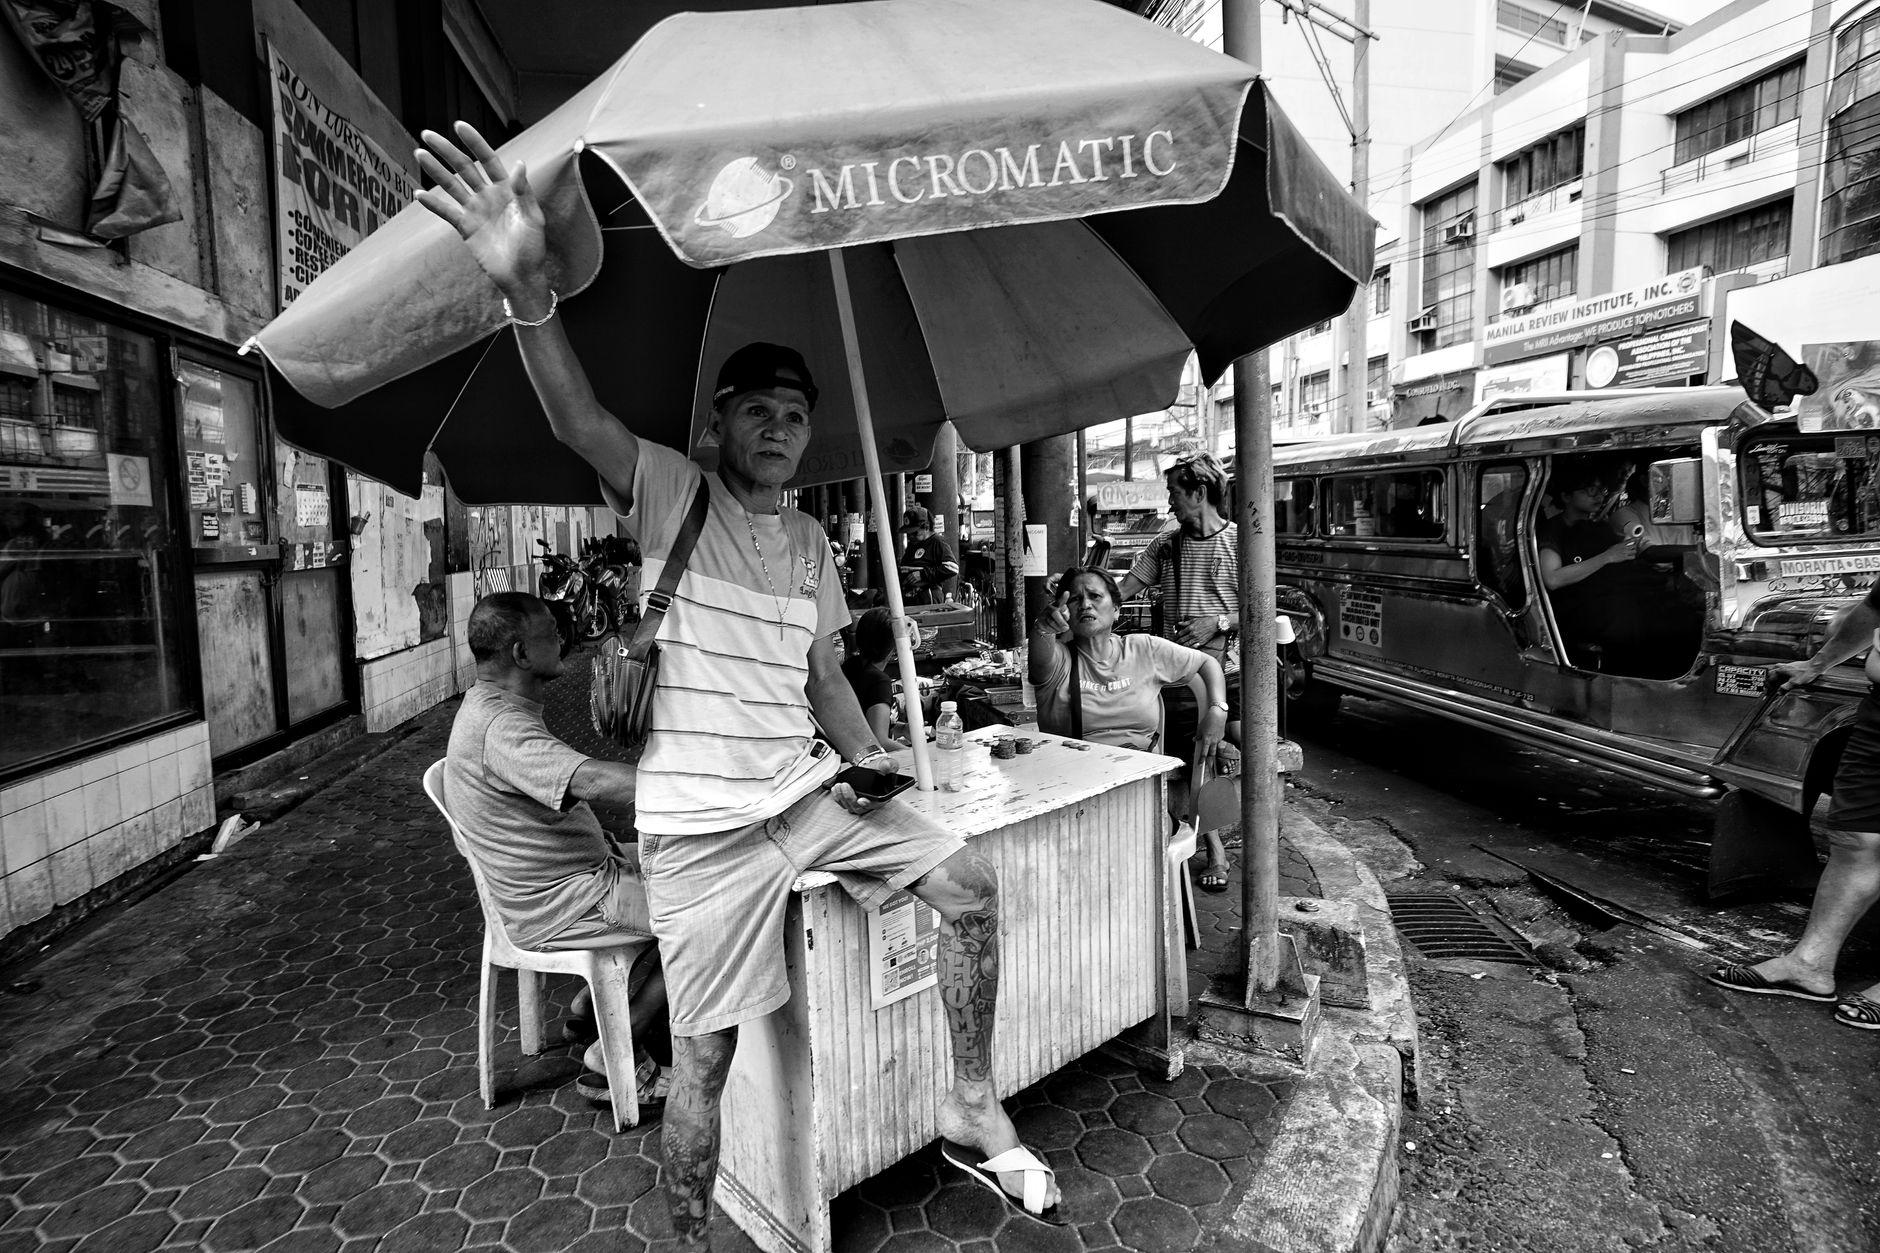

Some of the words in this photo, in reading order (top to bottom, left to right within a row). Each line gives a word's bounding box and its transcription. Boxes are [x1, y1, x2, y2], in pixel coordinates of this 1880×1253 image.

[283, 131, 361, 235] FOR
[806, 130, 1177, 214] MICROMATIC
[1487, 322, 1525, 340] MANILA
[1529, 310, 1568, 330] REVIEW
[1572, 292, 1638, 320] INSTITUTE,
[1645, 282, 1673, 300] INC.
[1598, 316, 1634, 334] PRODUCE
[1634, 300, 1695, 326] TOPNOTCHERS
[1783, 559, 1846, 574] MORAYTA
[1718, 665, 1767, 677] CAPACITY
[943, 951, 987, 1082] HOMER
